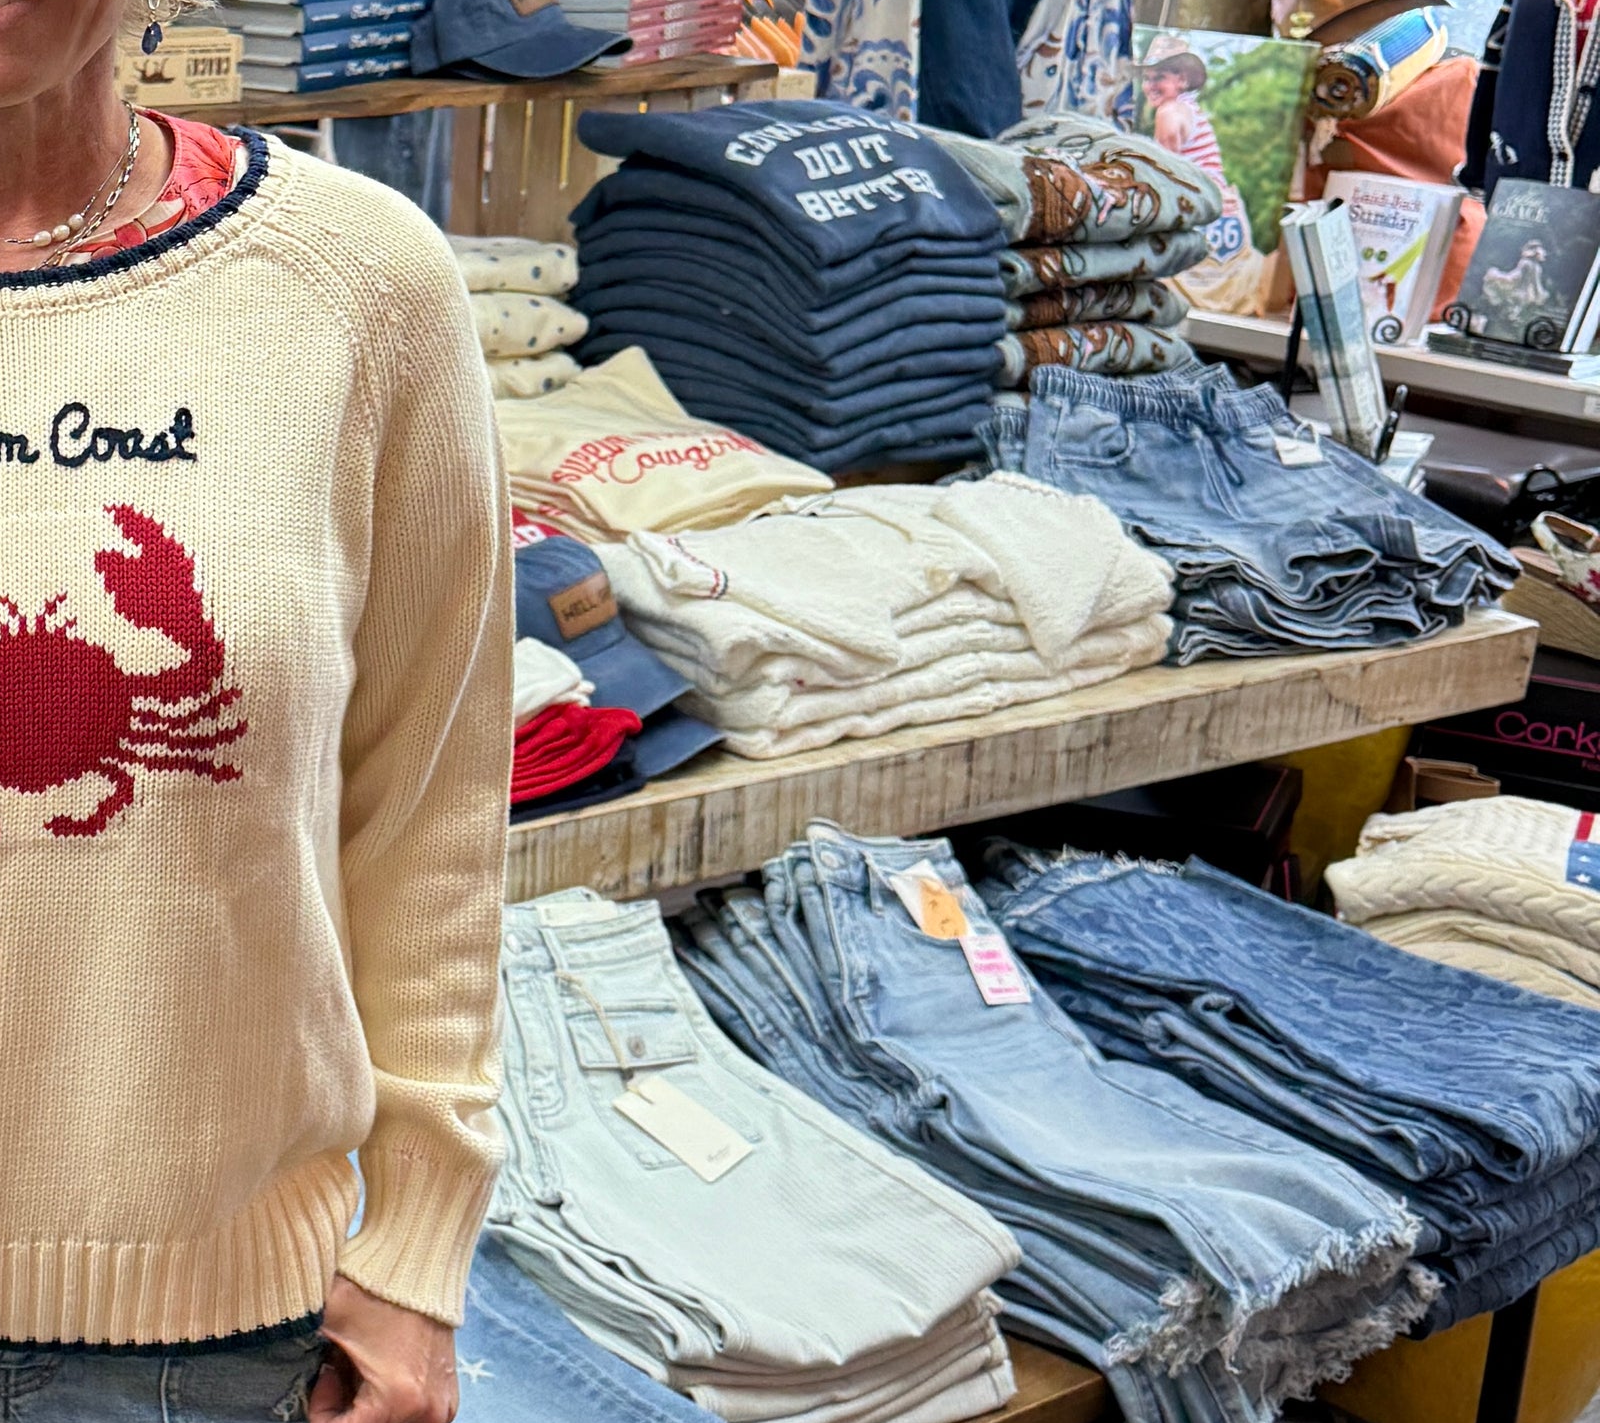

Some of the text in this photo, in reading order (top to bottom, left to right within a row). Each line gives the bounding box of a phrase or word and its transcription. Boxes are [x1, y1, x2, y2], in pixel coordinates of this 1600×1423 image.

[792, 133, 895, 181] DO IT
[795, 166, 945, 223] BETTER
[1349, 204, 1419, 236] Sunday
[50, 401, 198, 468] Coast
[1494, 709, 1600, 761] Cork
